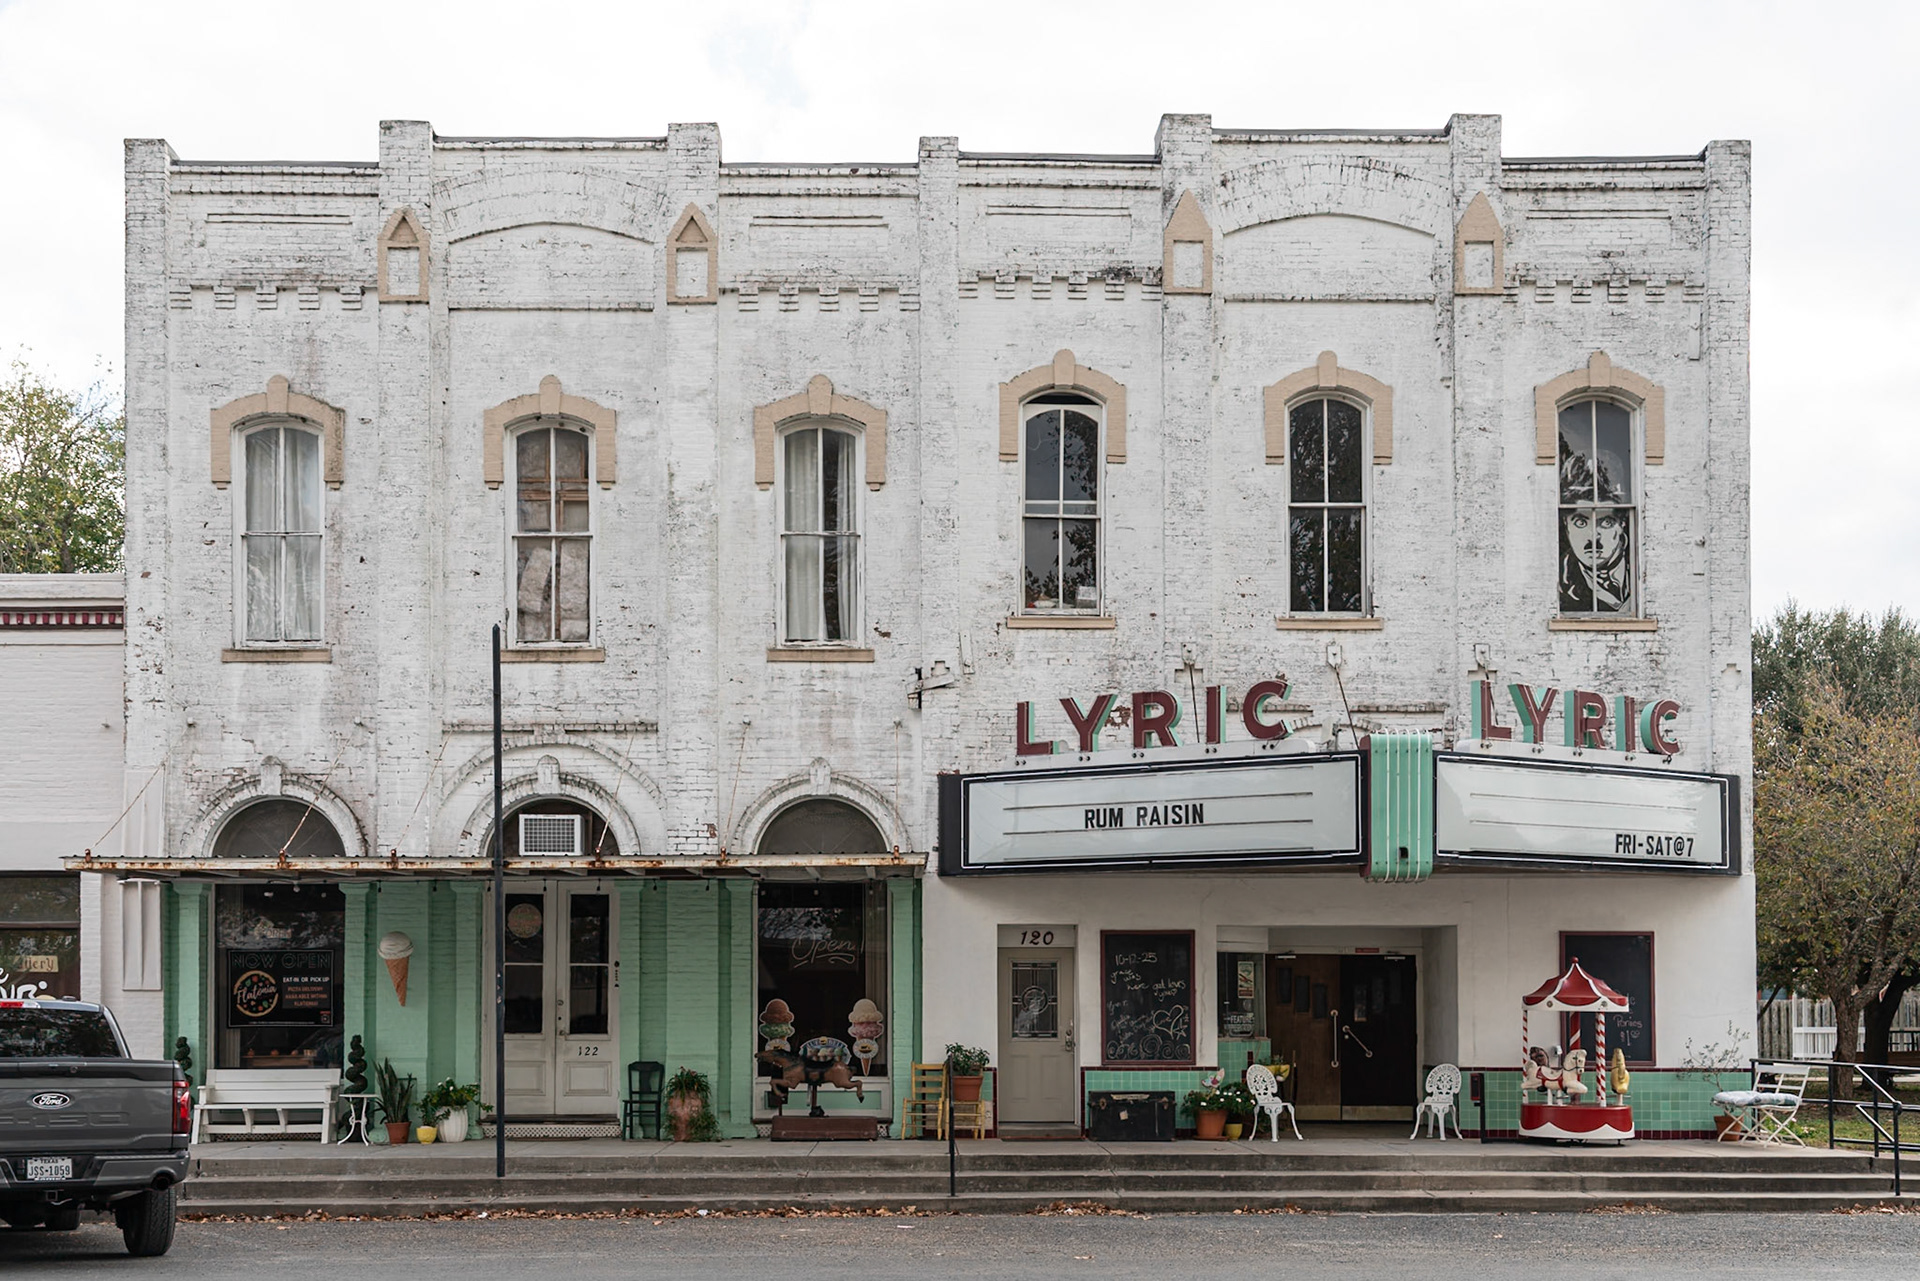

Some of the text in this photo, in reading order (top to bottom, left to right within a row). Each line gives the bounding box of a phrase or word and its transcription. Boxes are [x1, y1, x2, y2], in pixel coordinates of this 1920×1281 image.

[1016, 680, 1292, 756] LYRIC
[1471, 680, 1682, 755] LYRIC
[1085, 803, 1204, 829] RUM RAISIN
[1615, 833, 1694, 857] FRI-SAT@7
[792, 930, 856, 966] Open
[1021, 931, 1054, 945] 120
[231, 953, 331, 969] NOW OPEN
[578, 1046, 599, 1056] 122
[39, 1095, 64, 1106] Ford
